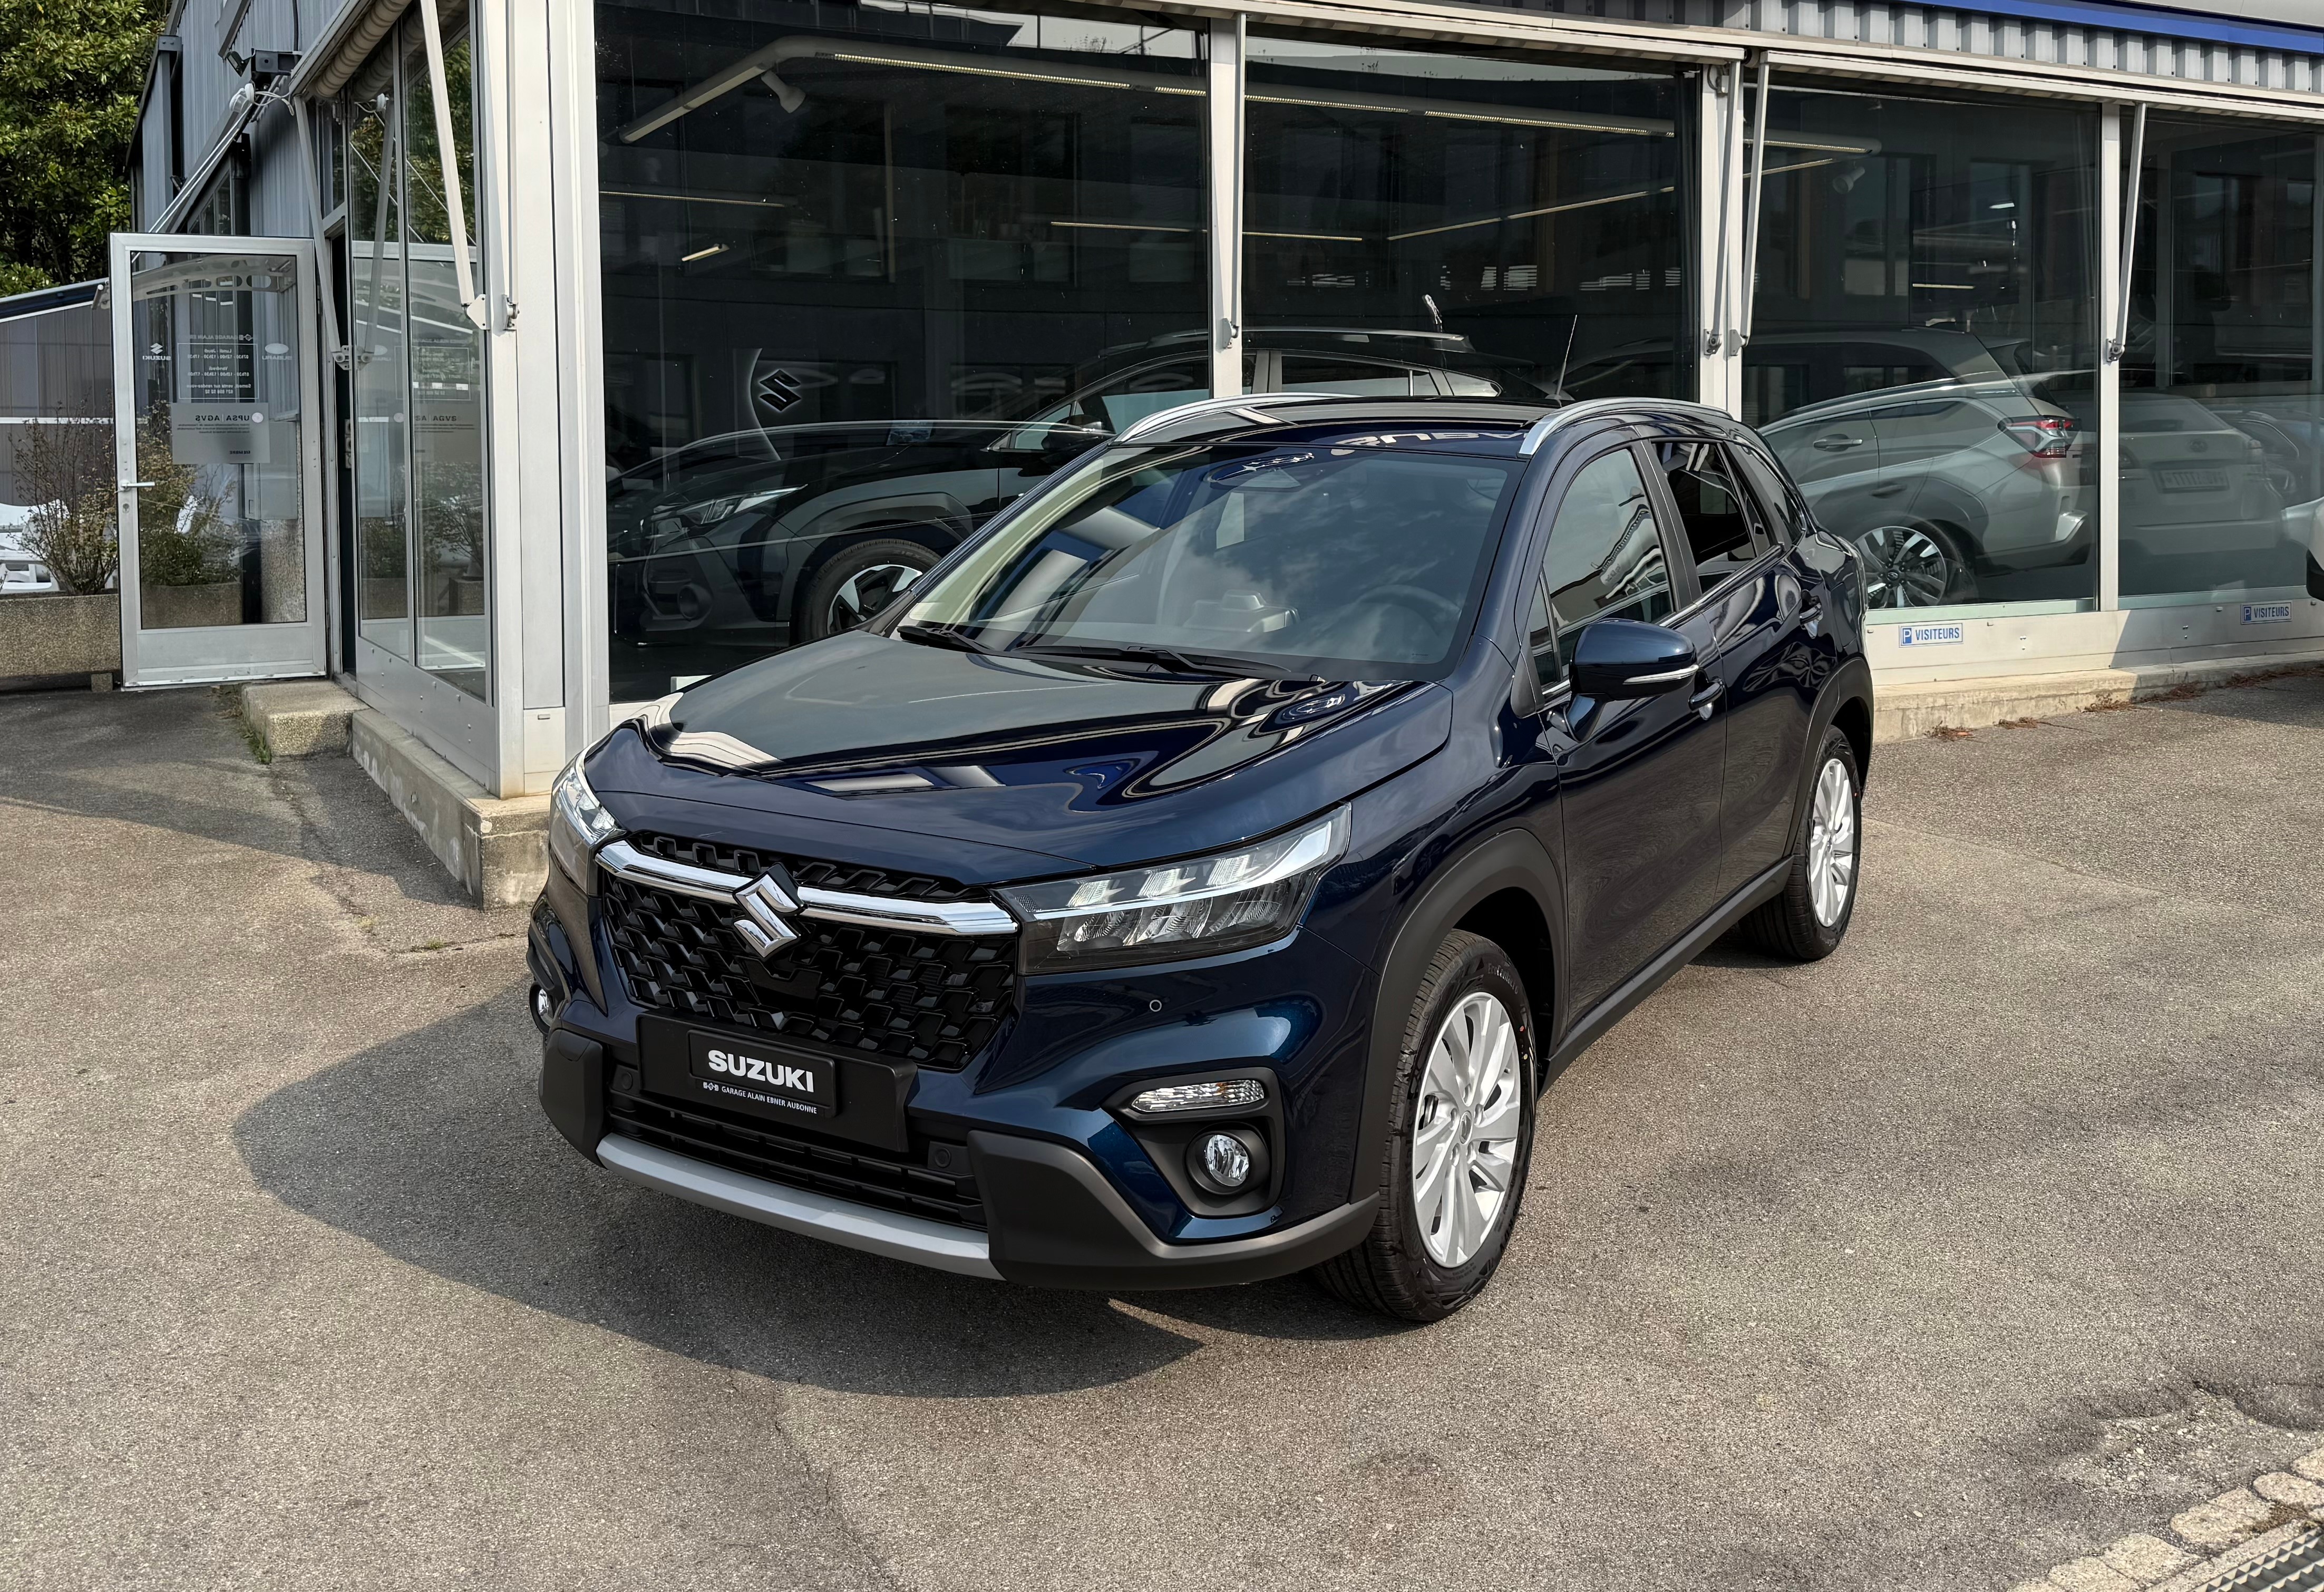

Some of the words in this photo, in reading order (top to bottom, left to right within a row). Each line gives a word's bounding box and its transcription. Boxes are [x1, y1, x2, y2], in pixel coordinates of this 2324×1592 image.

[2254, 606, 2289, 618] VISITEURS
[1915, 627, 1960, 640] VISITEURS
[708, 1050, 814, 1093] SUZUKI
[721, 1085, 746, 1098] GARAGE
[747, 1092, 765, 1102] ALAIN
[766, 1095, 786, 1107] EBNER
[786, 1101, 818, 1114] AUBONNE
